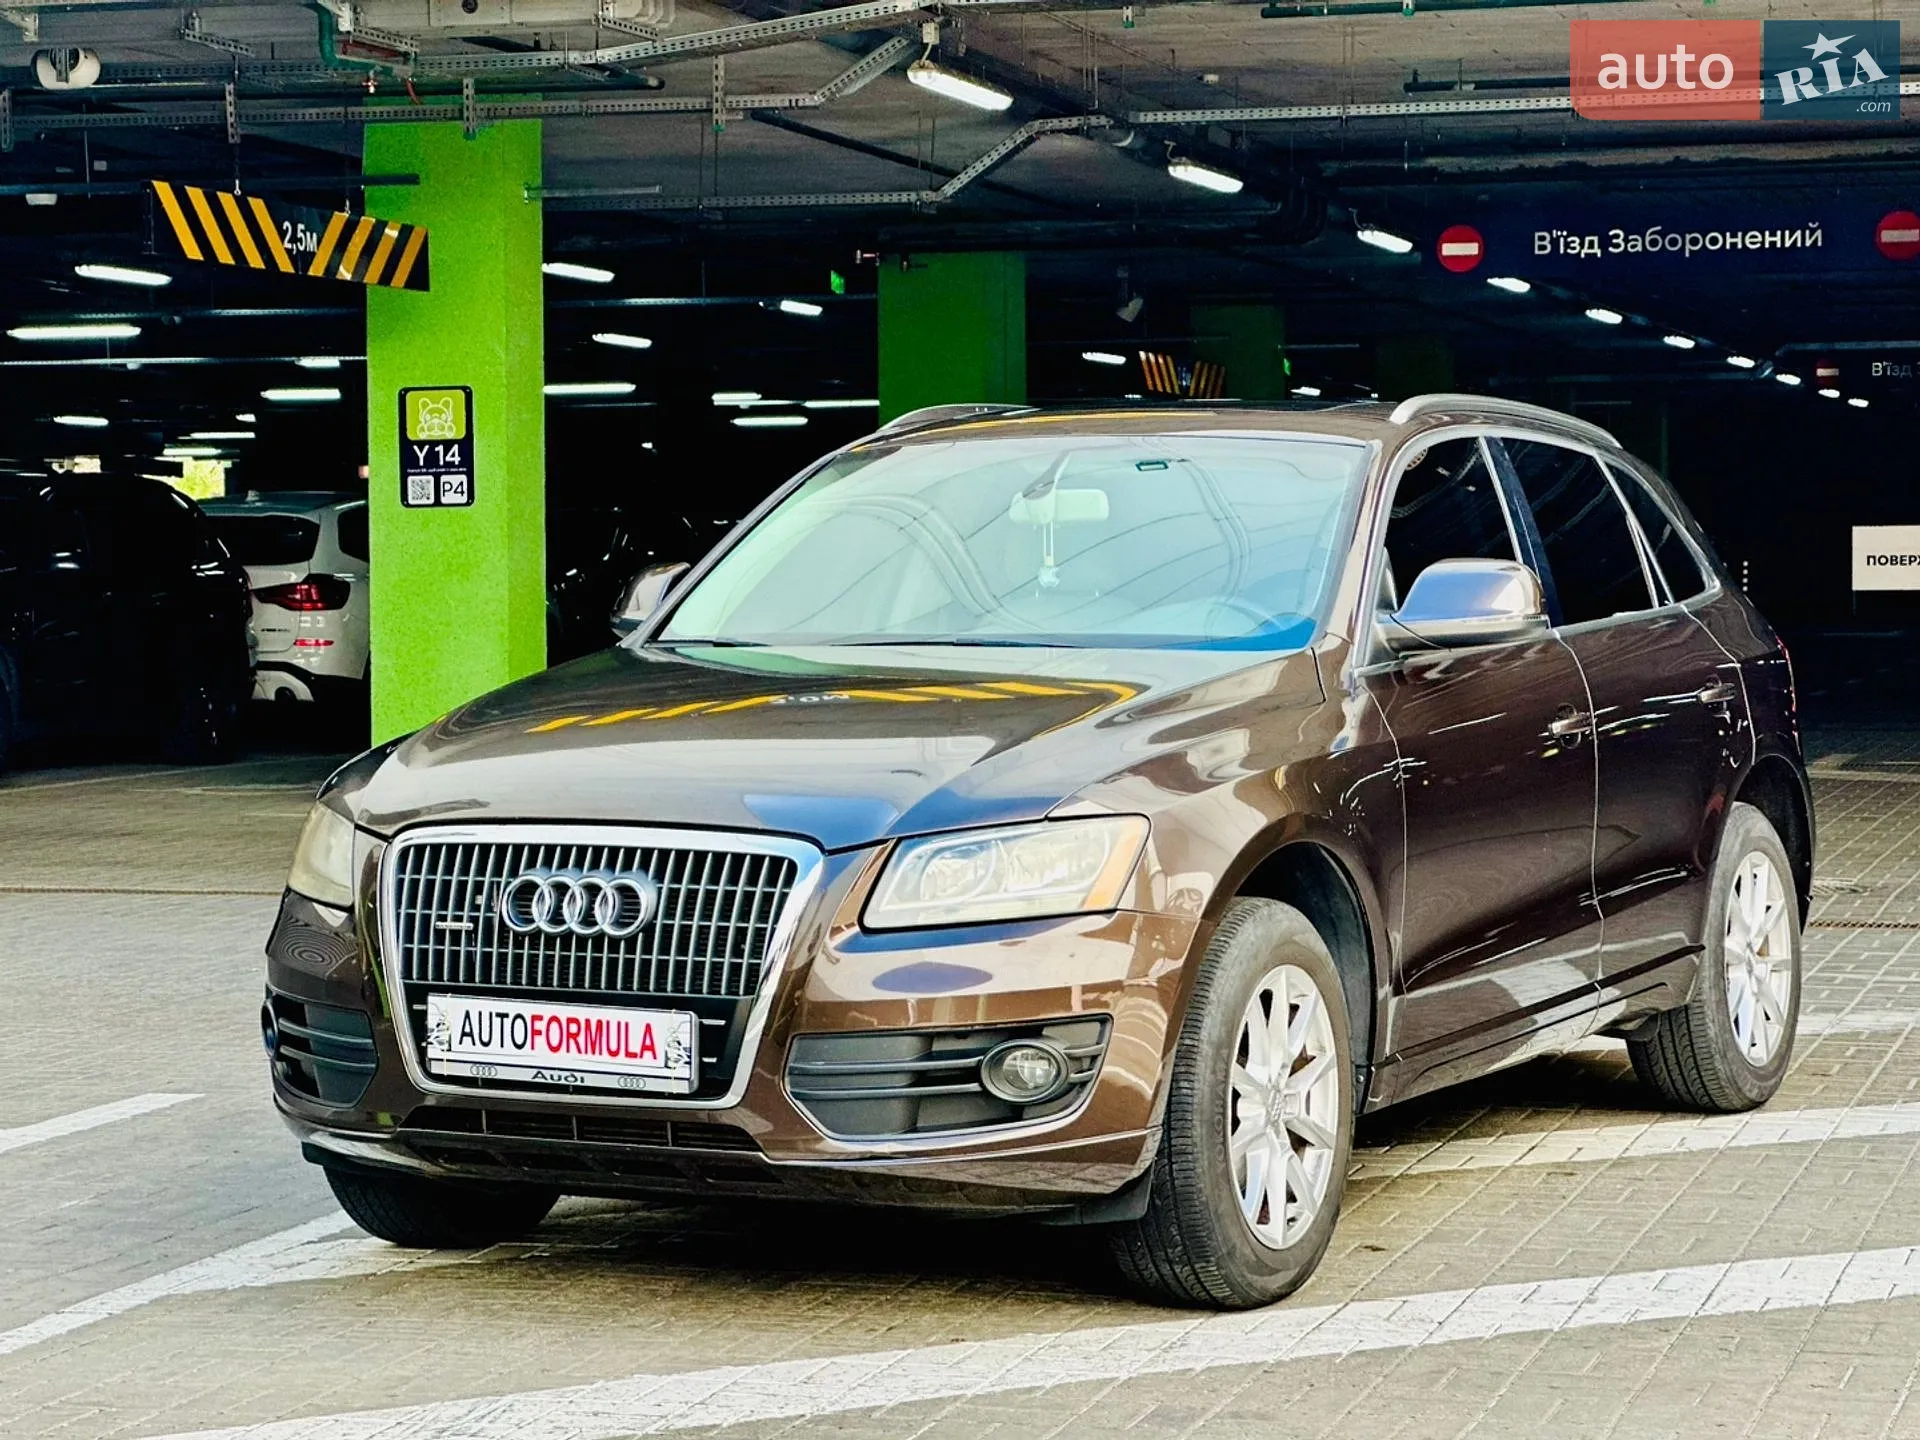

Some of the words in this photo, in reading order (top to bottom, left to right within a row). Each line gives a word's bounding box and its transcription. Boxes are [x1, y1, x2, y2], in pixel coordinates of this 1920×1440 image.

[1608, 221, 1823, 258] Заборонений
[412, 444, 430, 467] Y
[434, 443, 462, 466] 14
[441, 480, 465, 498] P4
[1866, 554, 1920, 567] ПОВЕР
[458, 1009, 658, 1061] AUTOFORMULA
[531, 1070, 586, 1085] Audi
